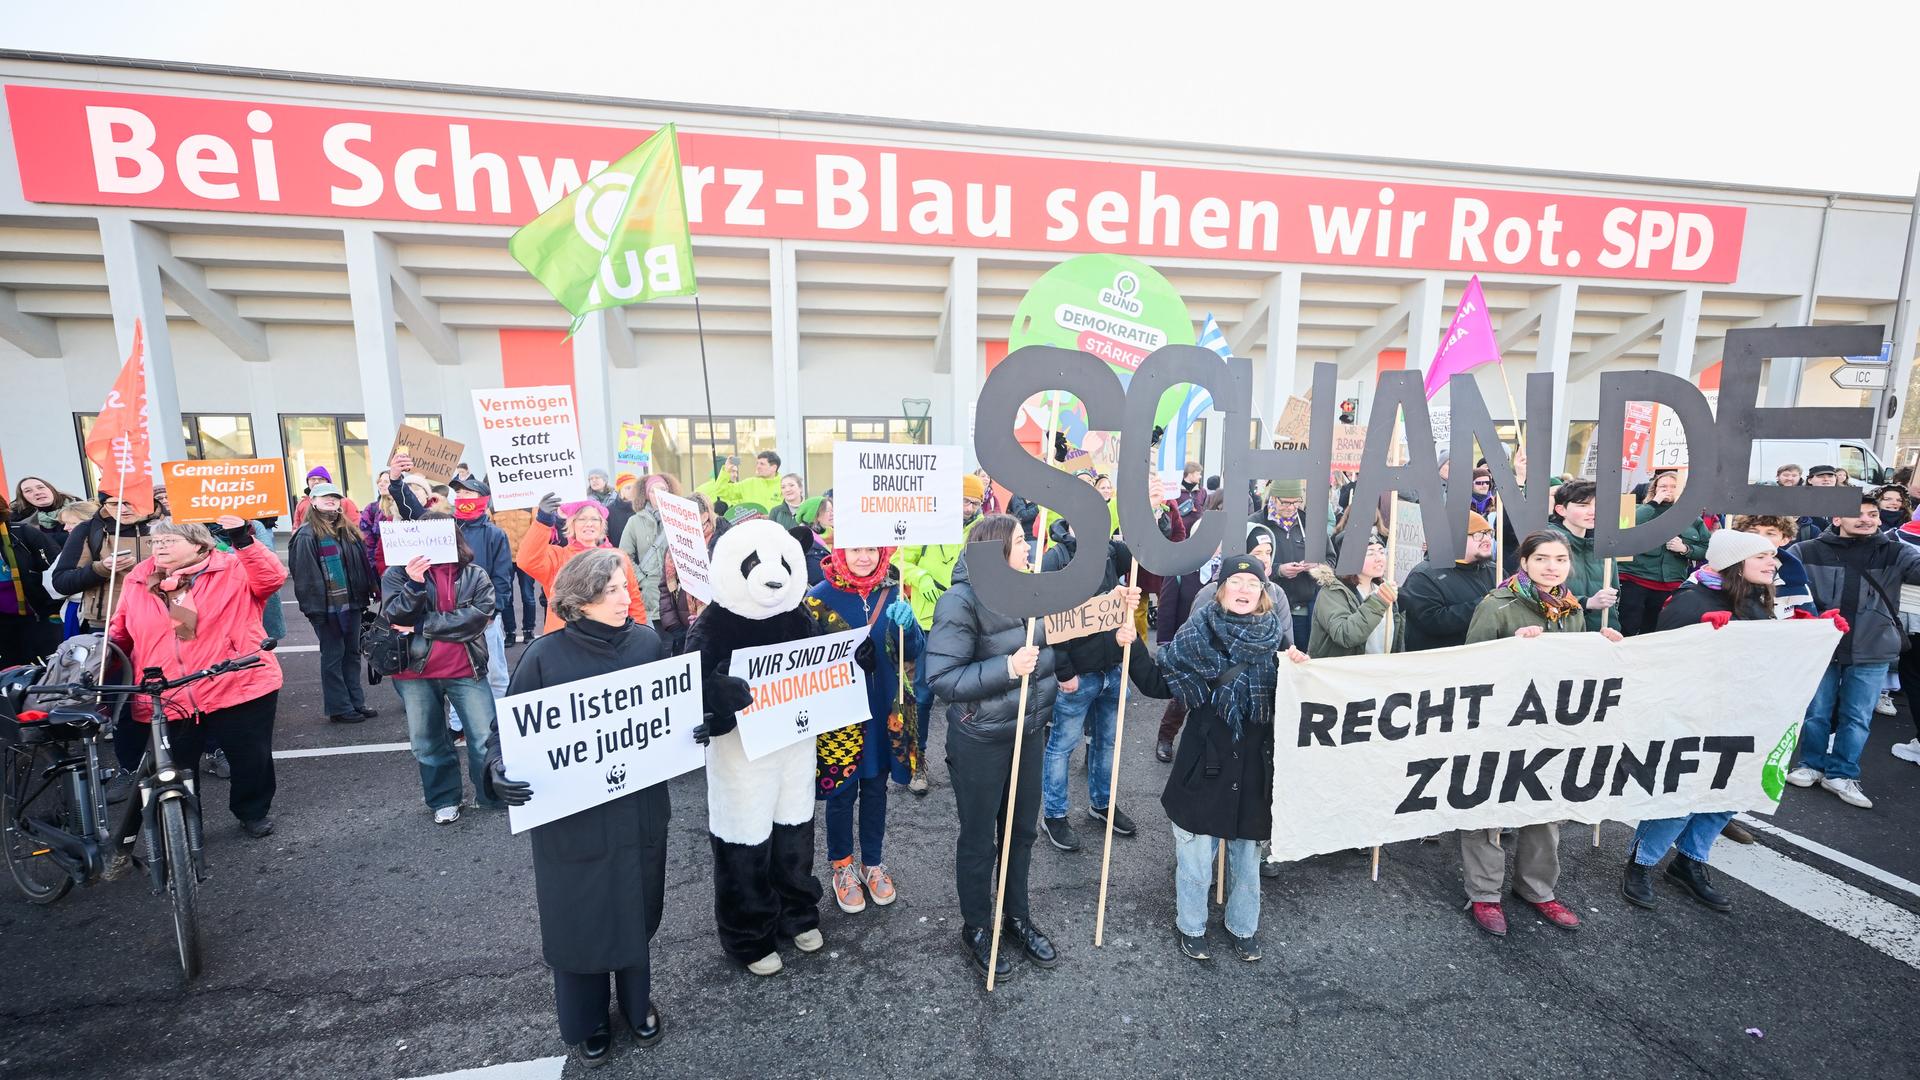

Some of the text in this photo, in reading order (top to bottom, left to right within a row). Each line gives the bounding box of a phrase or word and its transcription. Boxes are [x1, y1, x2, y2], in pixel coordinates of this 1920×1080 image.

[85, 105, 1715, 272] Bei Schwrz-Blau sehen wir Rot. SPD
[1103, 291, 1139, 313] BUND
[1063, 309, 1158, 346] DEMOKRATIE
[1855, 371, 1871, 383] ICC
[480, 395, 568, 412] Vermögen
[483, 413, 570, 430] besteuern
[512, 431, 550, 447] statt
[424, 440, 457, 463] halten
[490, 448, 576, 468] Rechtsruck
[859, 452, 937, 470] KLIMASCHUTZ
[172, 462, 275, 477] Gemeinsam
[498, 464, 573, 484] befeuern!
[201, 478, 255, 493] Nazis
[873, 475, 924, 491] BRAUCHT
[191, 493, 268, 510] stoppen
[658, 497, 698, 522] Vermögen
[861, 496, 937, 513] DEMOKRATIE!
[662, 511, 701, 537] besteuern
[675, 533, 694, 550] statt
[670, 544, 708, 571] Rechtsruck
[676, 559, 710, 584] befeuern!
[1048, 599, 1121, 634] SHAME ON
[1098, 611, 1125, 630] YOU
[748, 640, 854, 680] WIR SIND DIE
[742, 661, 856, 717] RANDMAUER!
[512, 663, 692, 738] We listen and
[1297, 677, 1623, 747] RECHT AUF
[547, 706, 671, 771] we judge!
[1394, 735, 1755, 815] ZUKUNFT
[607, 782, 627, 794] WWF
